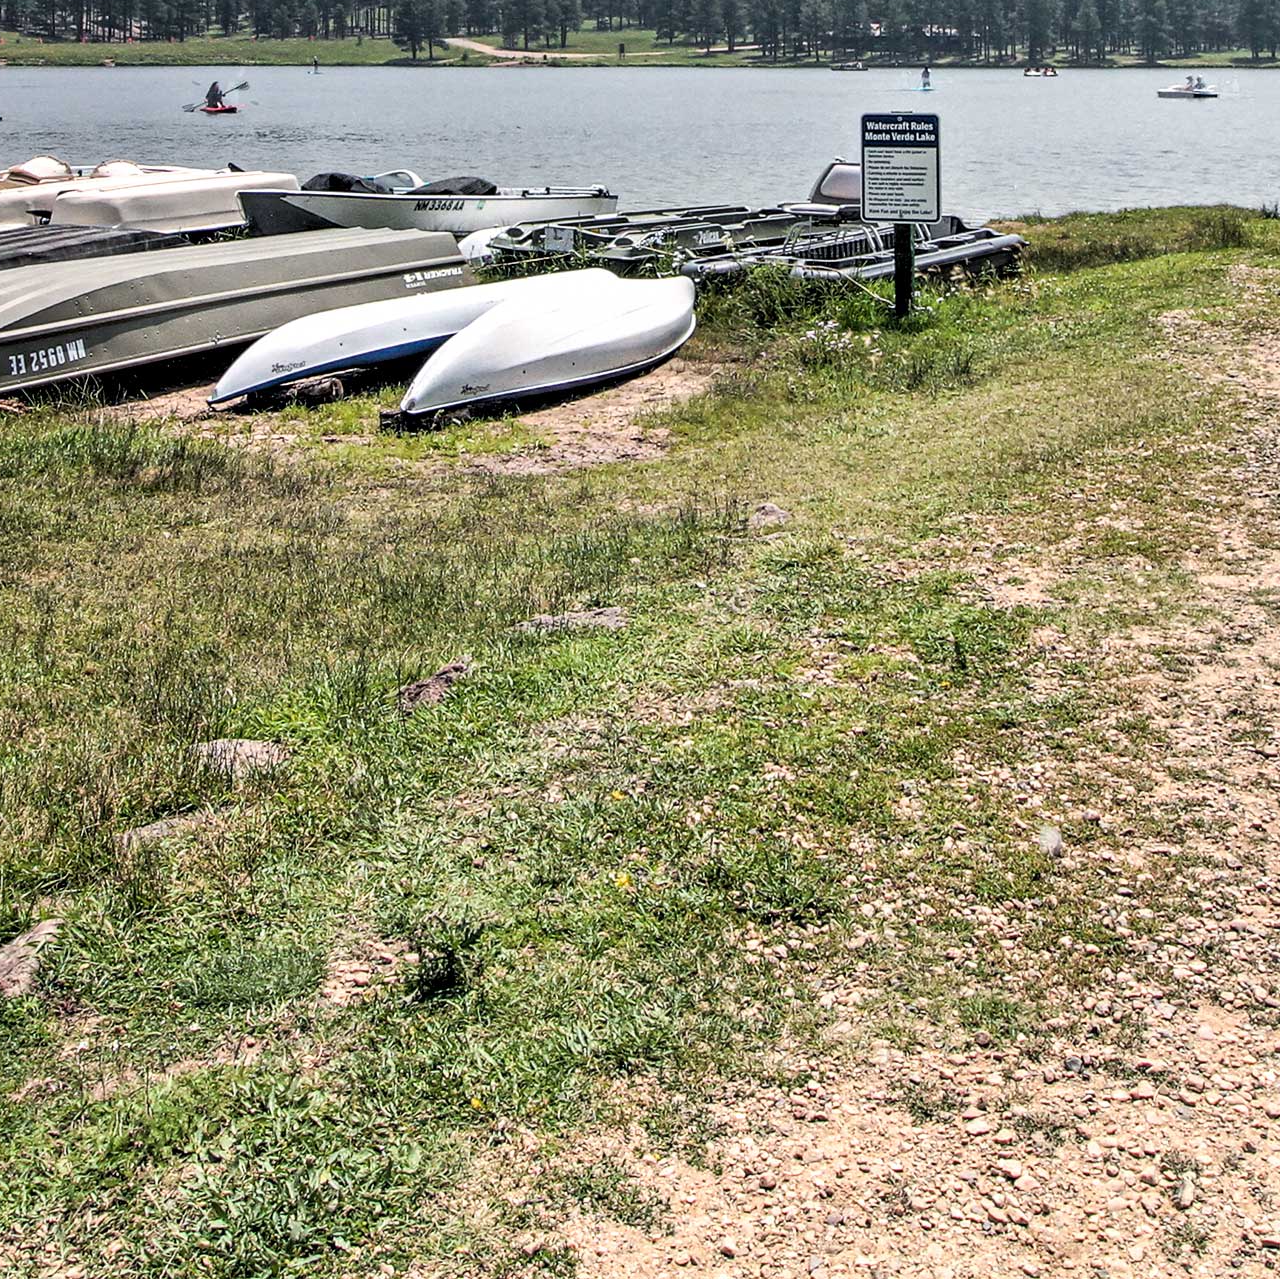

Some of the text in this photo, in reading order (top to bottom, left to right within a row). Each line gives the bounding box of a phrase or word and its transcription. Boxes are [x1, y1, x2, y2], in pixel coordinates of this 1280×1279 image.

[866, 122, 934, 131] Watercraft Rules
[864, 132, 936, 141] Monte Verde Lake
[423, 267, 463, 279] TRACKER
[8, 338, 86, 376] NM 8952 EE
